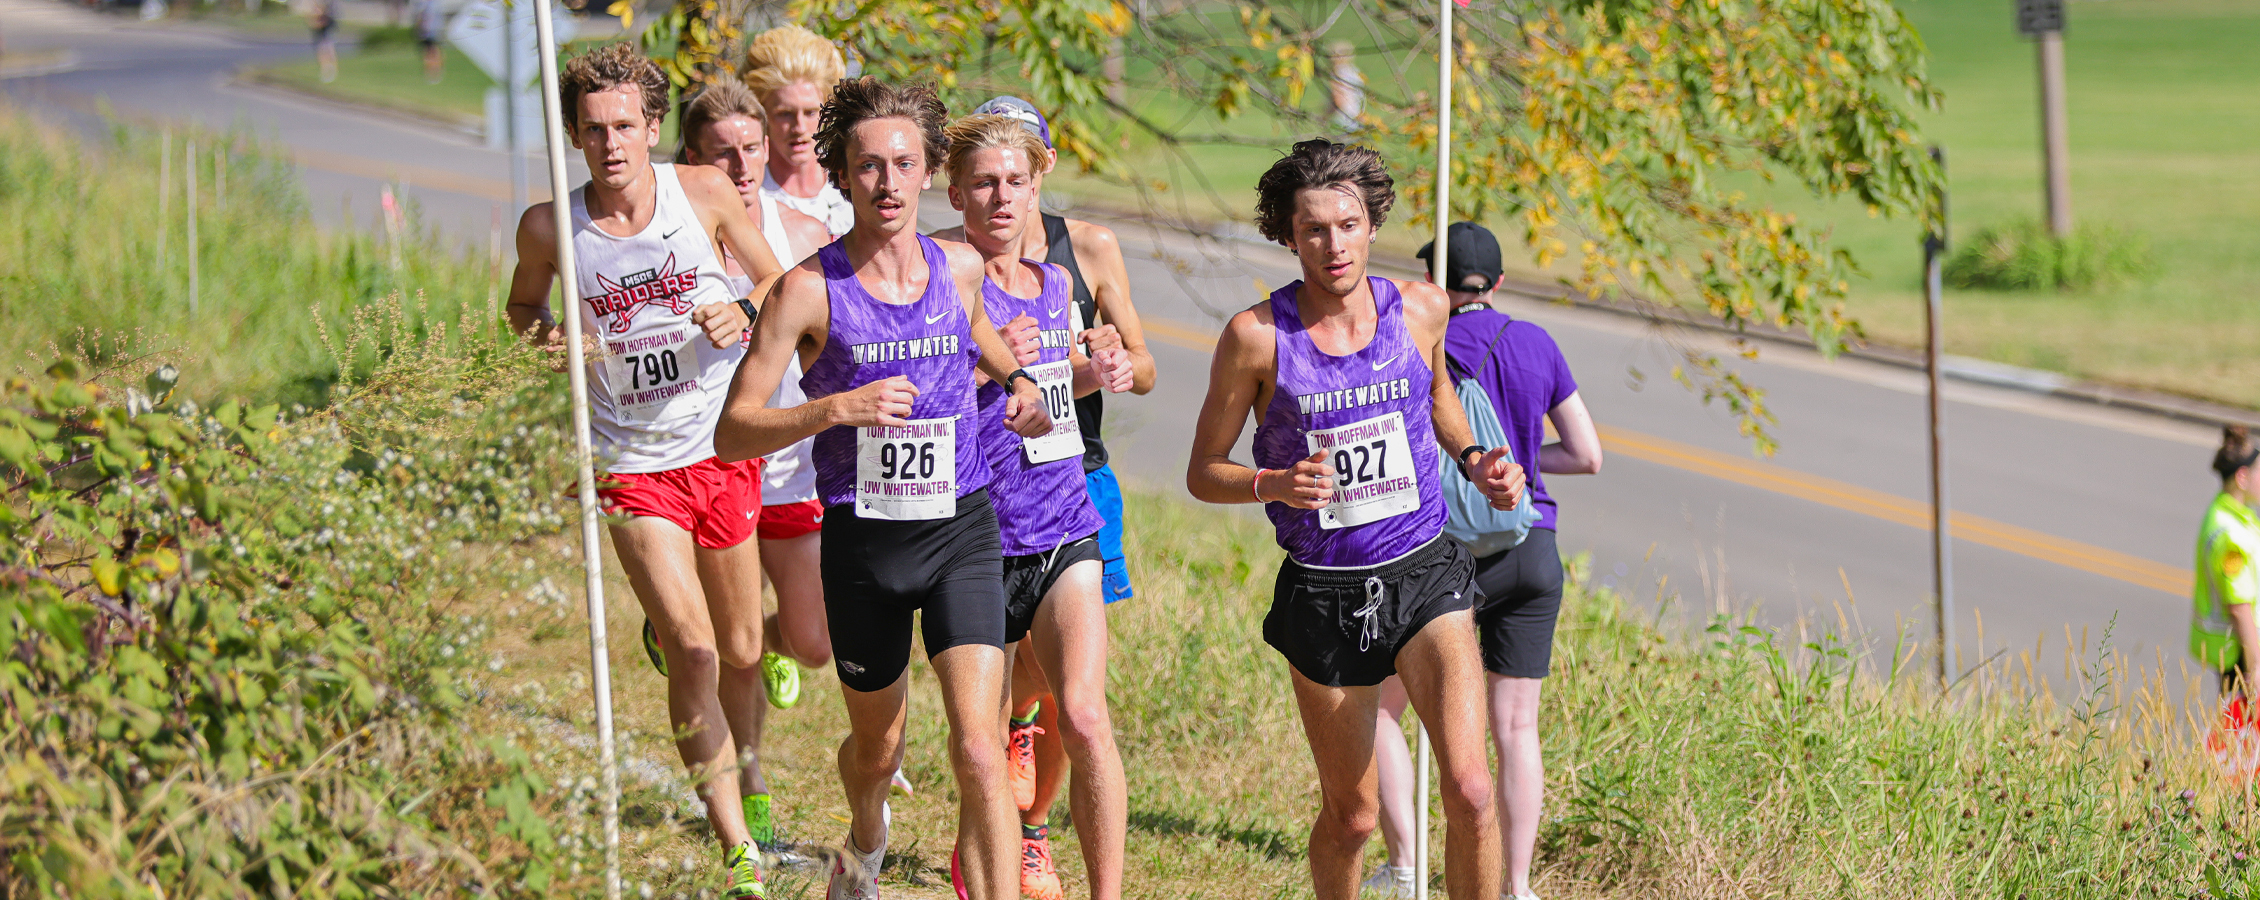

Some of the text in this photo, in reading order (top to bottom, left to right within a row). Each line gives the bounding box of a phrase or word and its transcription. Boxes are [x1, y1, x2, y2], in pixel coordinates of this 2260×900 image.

[588, 267, 698, 316] RAIDERS
[624, 270, 654, 287] MSOE
[608, 330, 687, 355] TOM HOFFMAN INV.
[851, 334, 959, 365] WHITEWATER
[625, 349, 679, 390] 790
[1038, 366, 1064, 382] HOFFMAN
[620, 393, 635, 406] UW
[636, 379, 698, 404] WHITEWATER
[1297, 377, 1410, 415] WHITEWATER
[867, 423, 950, 439] TOM HOFFMAN INV.
[1315, 418, 1398, 449] TOM HOFFMAN INV.
[881, 442, 935, 480] 926
[1334, 439, 1387, 487] 927
[864, 481, 949, 496] UW WHITEWATER
[1328, 490, 1341, 503] W
[1343, 476, 1411, 503] WHITEWATER
